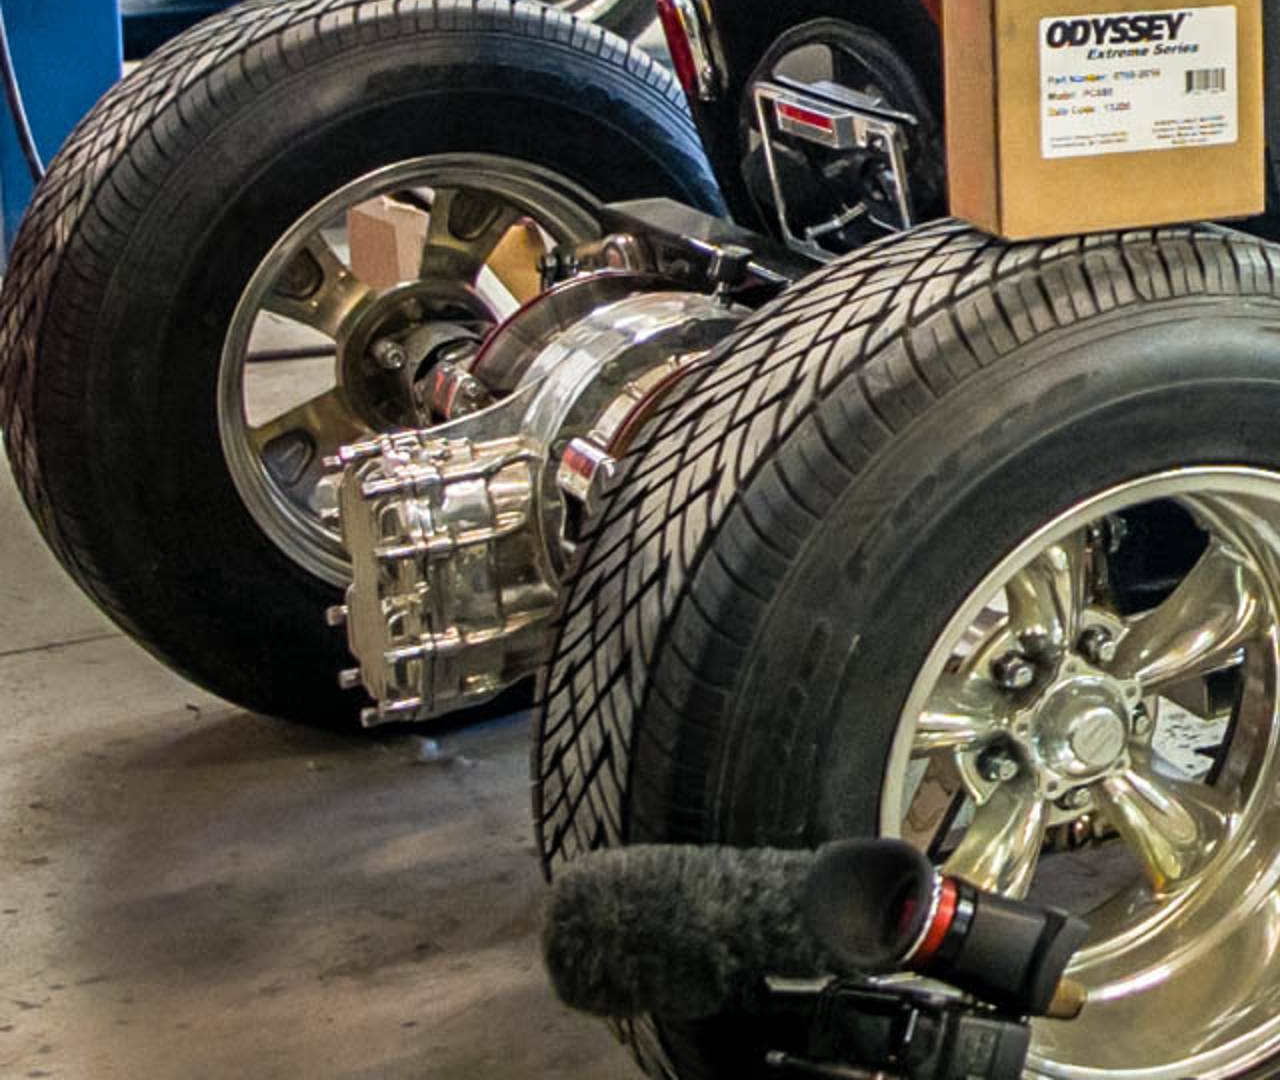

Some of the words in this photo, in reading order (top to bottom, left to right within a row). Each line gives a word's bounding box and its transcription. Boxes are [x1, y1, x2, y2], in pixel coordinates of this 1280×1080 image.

[1047, 13, 1186, 48] ODYSSEY
[1087, 46, 1149, 60] Extreme
[1153, 43, 1199, 56] Series
